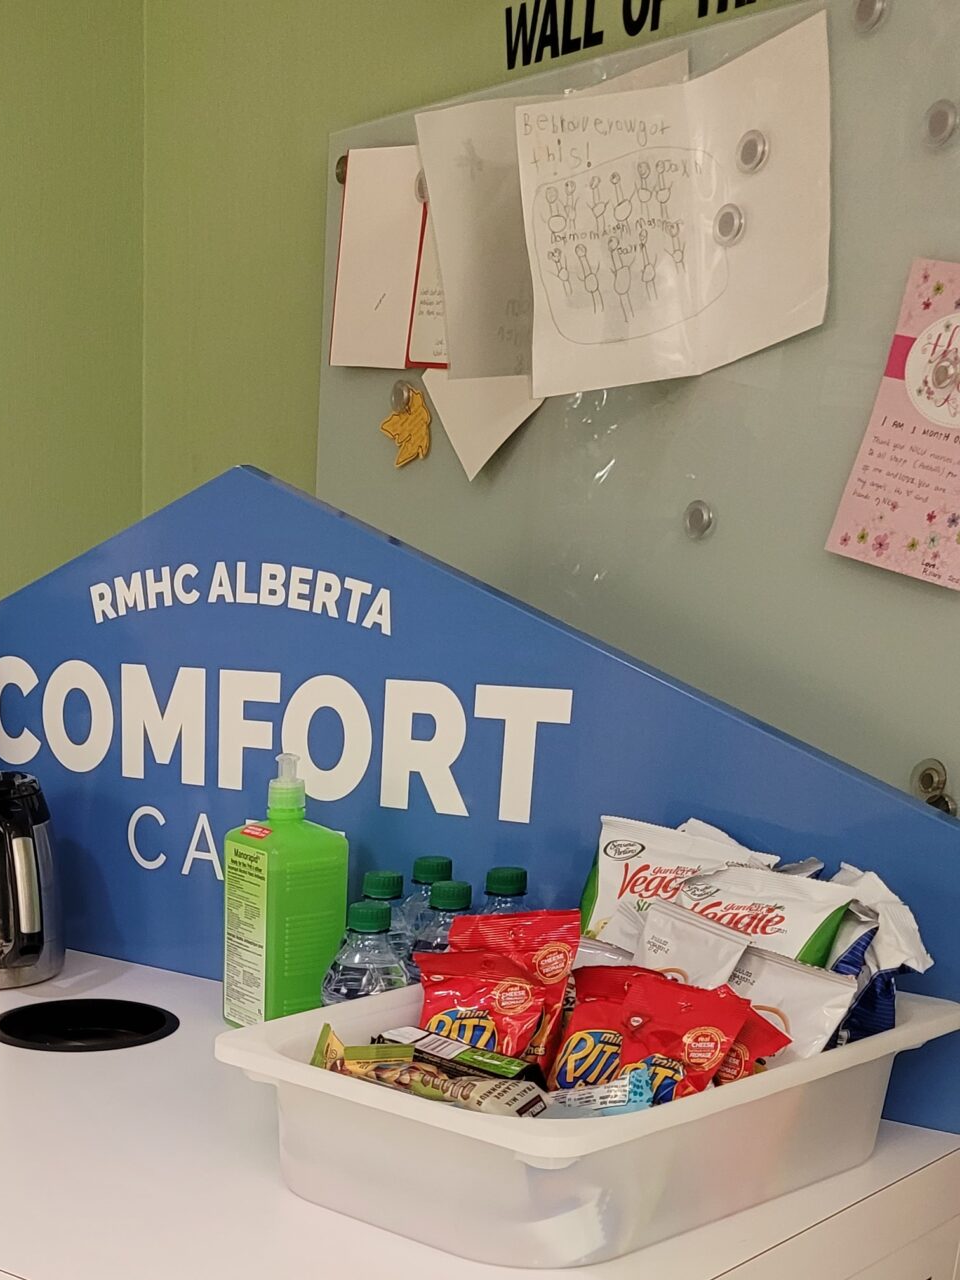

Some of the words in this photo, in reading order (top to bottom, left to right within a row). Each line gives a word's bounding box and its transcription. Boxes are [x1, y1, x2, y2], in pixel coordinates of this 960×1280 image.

[505, 0, 604, 71] WALL
[89, 562, 200, 624] RMHC
[208, 561, 392, 636] ALBERTA
[617, 863, 683, 900] Vegg
[501, 990, 526, 1000] CHEESE
[456, 1009, 489, 1019] mini
[601, 1032, 623, 1044] min
[494, 1080, 520, 1100] ÉLANGE
